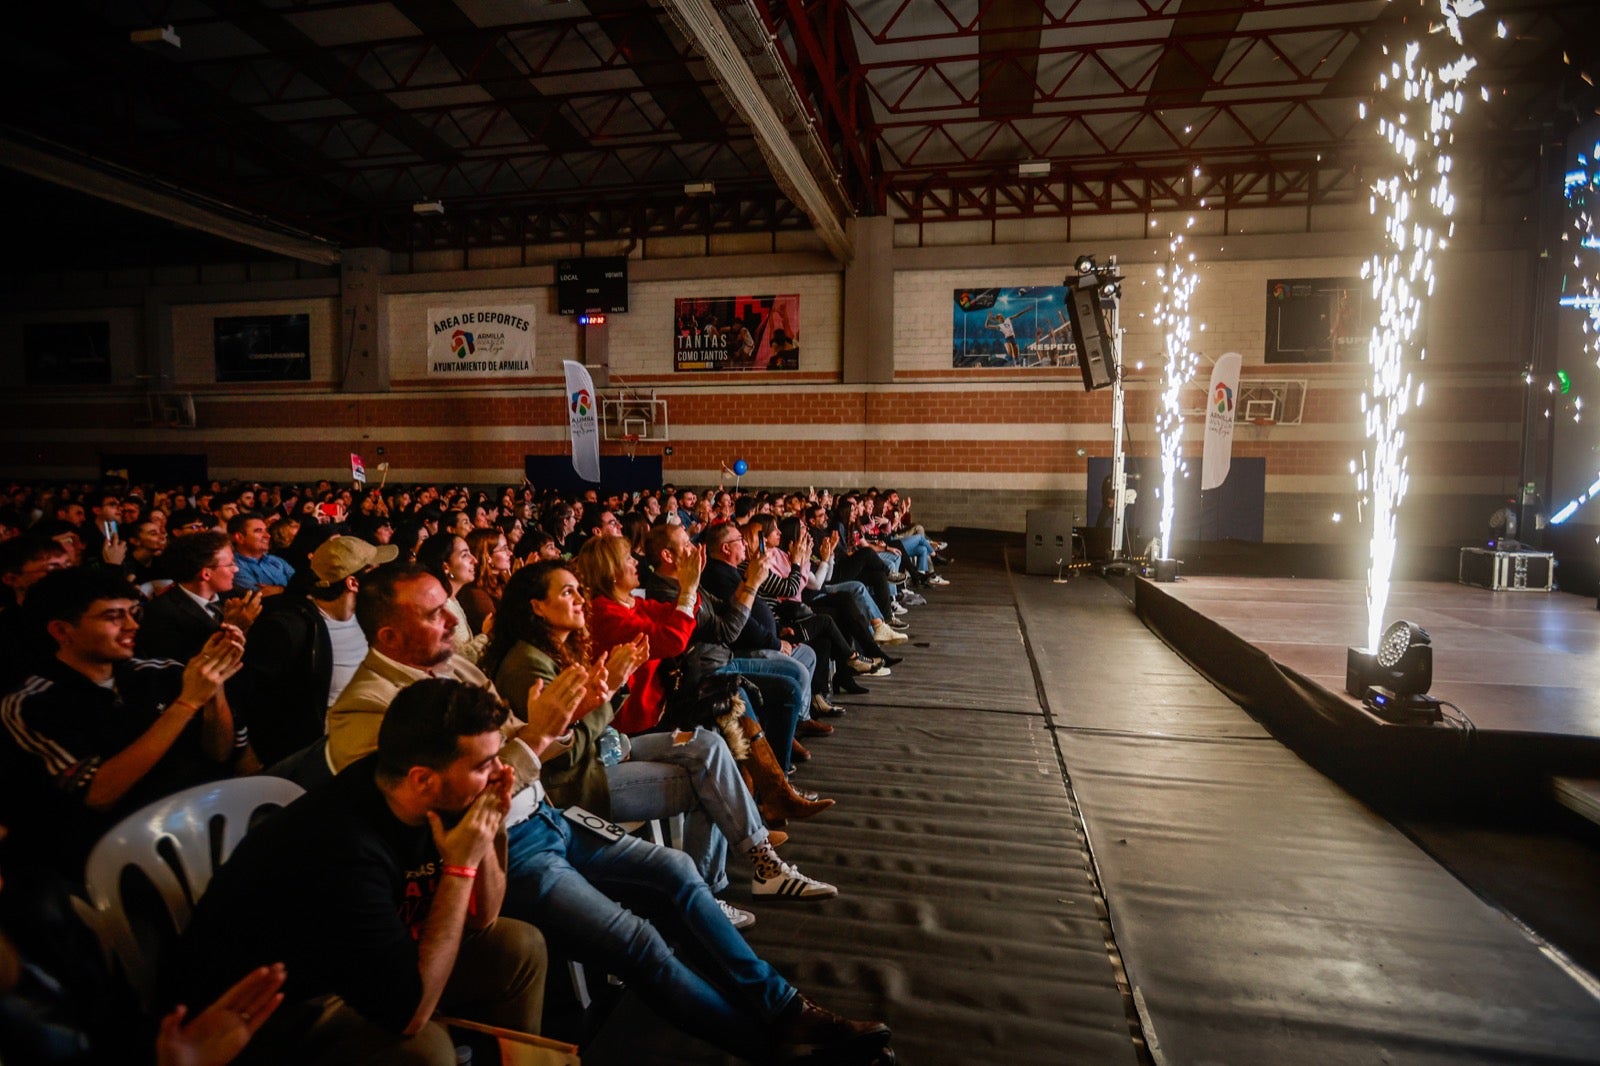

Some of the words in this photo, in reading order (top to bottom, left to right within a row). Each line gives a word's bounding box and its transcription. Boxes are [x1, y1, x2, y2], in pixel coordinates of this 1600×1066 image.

[462, 312, 475, 324] DE
[477, 312, 529, 331] DEPORTES
[678, 334, 727, 349] TANTAS
[1030, 343, 1077, 351] RESPETO
[677, 351, 699, 361] COMO
[701, 350, 728, 361] TANTOS
[433, 361, 487, 372] AYUNTAMIENTO
[488, 361, 497, 371] DE
[498, 361, 529, 370] ARMILLA
